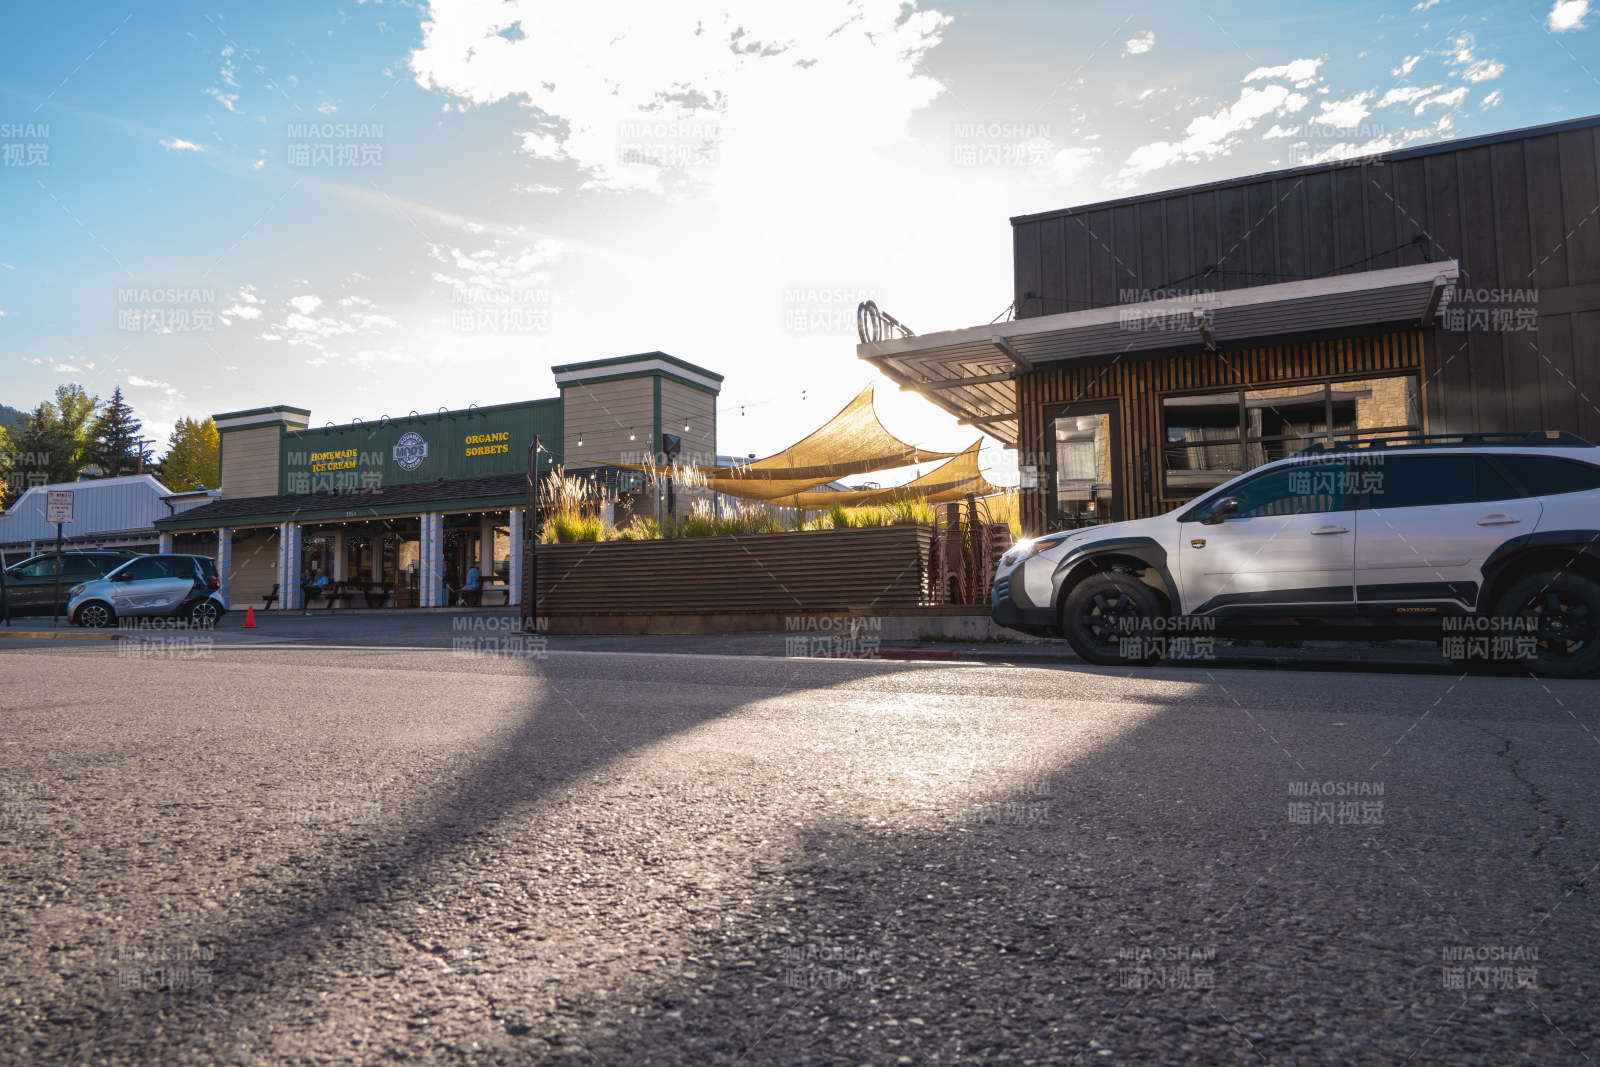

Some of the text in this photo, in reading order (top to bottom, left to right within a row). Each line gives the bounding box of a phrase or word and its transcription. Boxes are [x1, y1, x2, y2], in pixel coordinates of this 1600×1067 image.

[465, 432, 509, 445] ORGANIC
[311, 448, 358, 462] HOMEMADE
[466, 444, 509, 457] SORBETS
[312, 460, 357, 473] ICE CREAM
